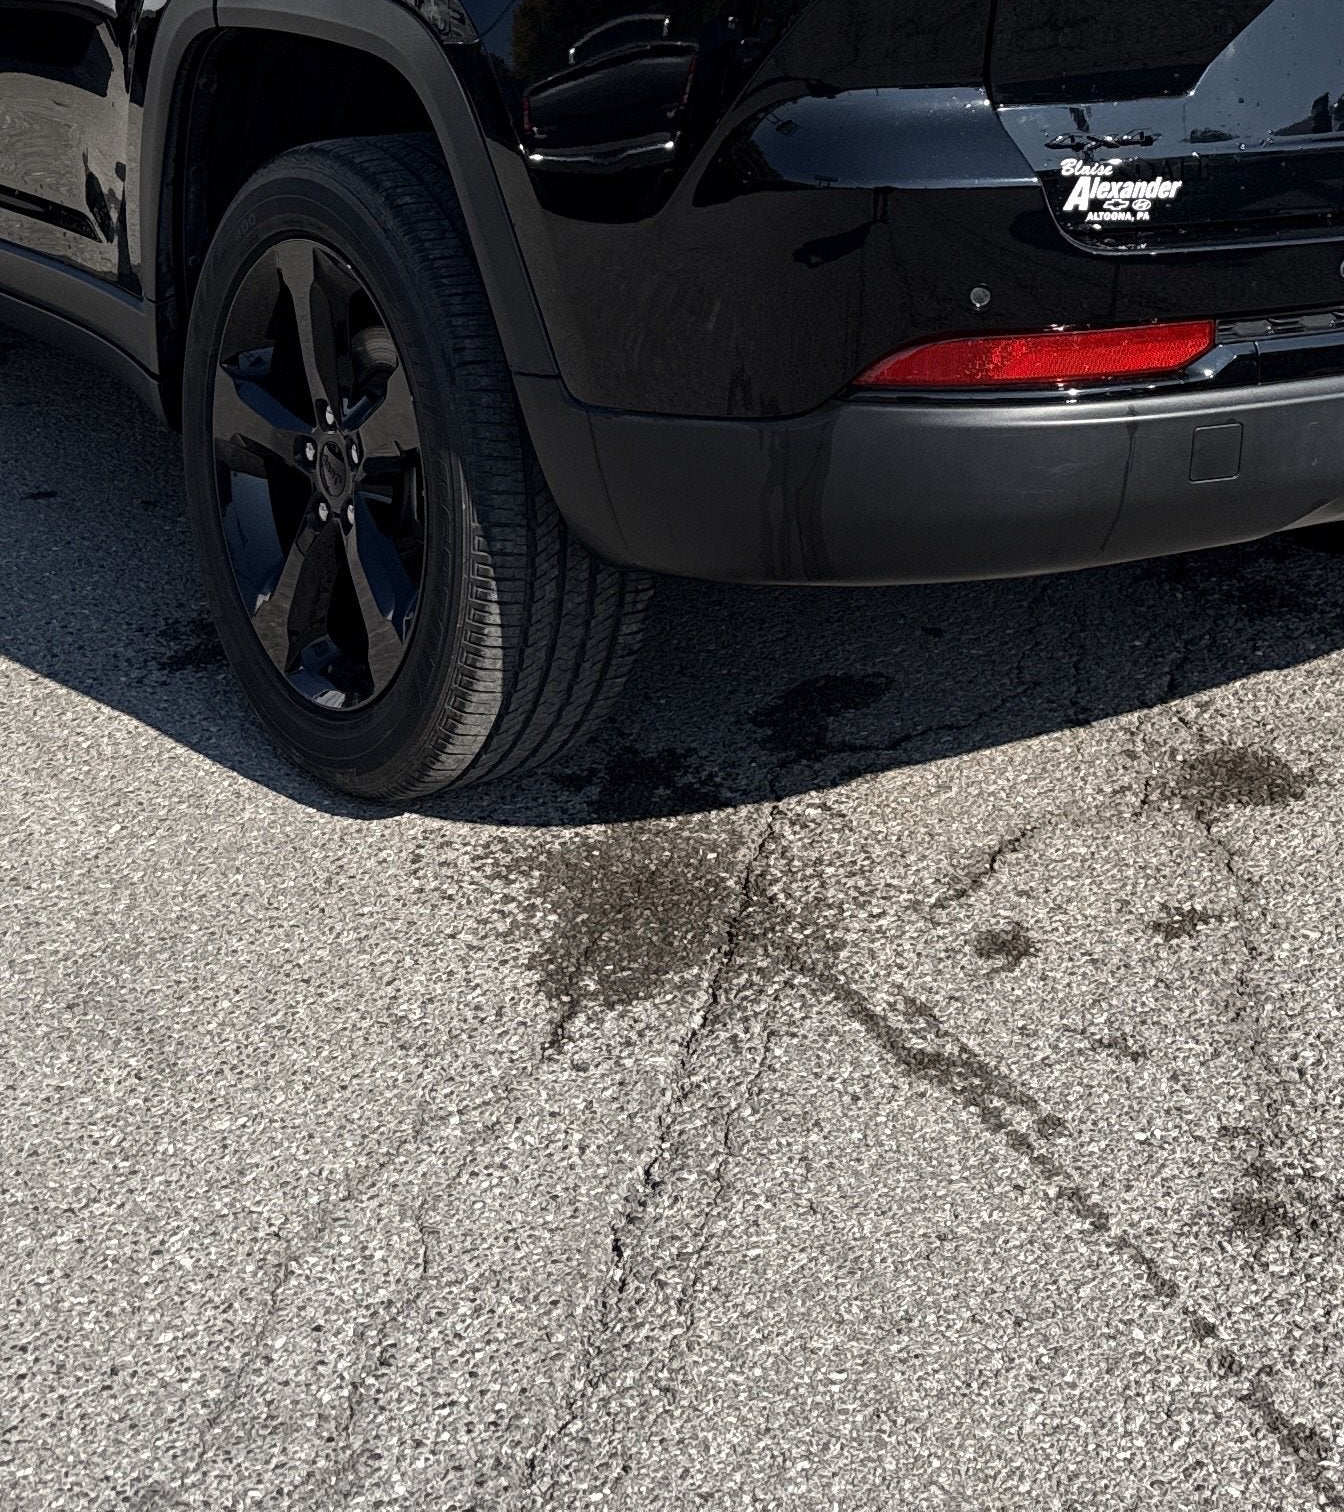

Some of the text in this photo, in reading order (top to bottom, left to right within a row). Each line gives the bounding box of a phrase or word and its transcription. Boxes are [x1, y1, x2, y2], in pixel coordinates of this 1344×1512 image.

[1060, 158, 1114, 176] Blaise
[1062, 176, 1182, 210] Alexander
[1085, 211, 1150, 222] ALTOONA, PA
